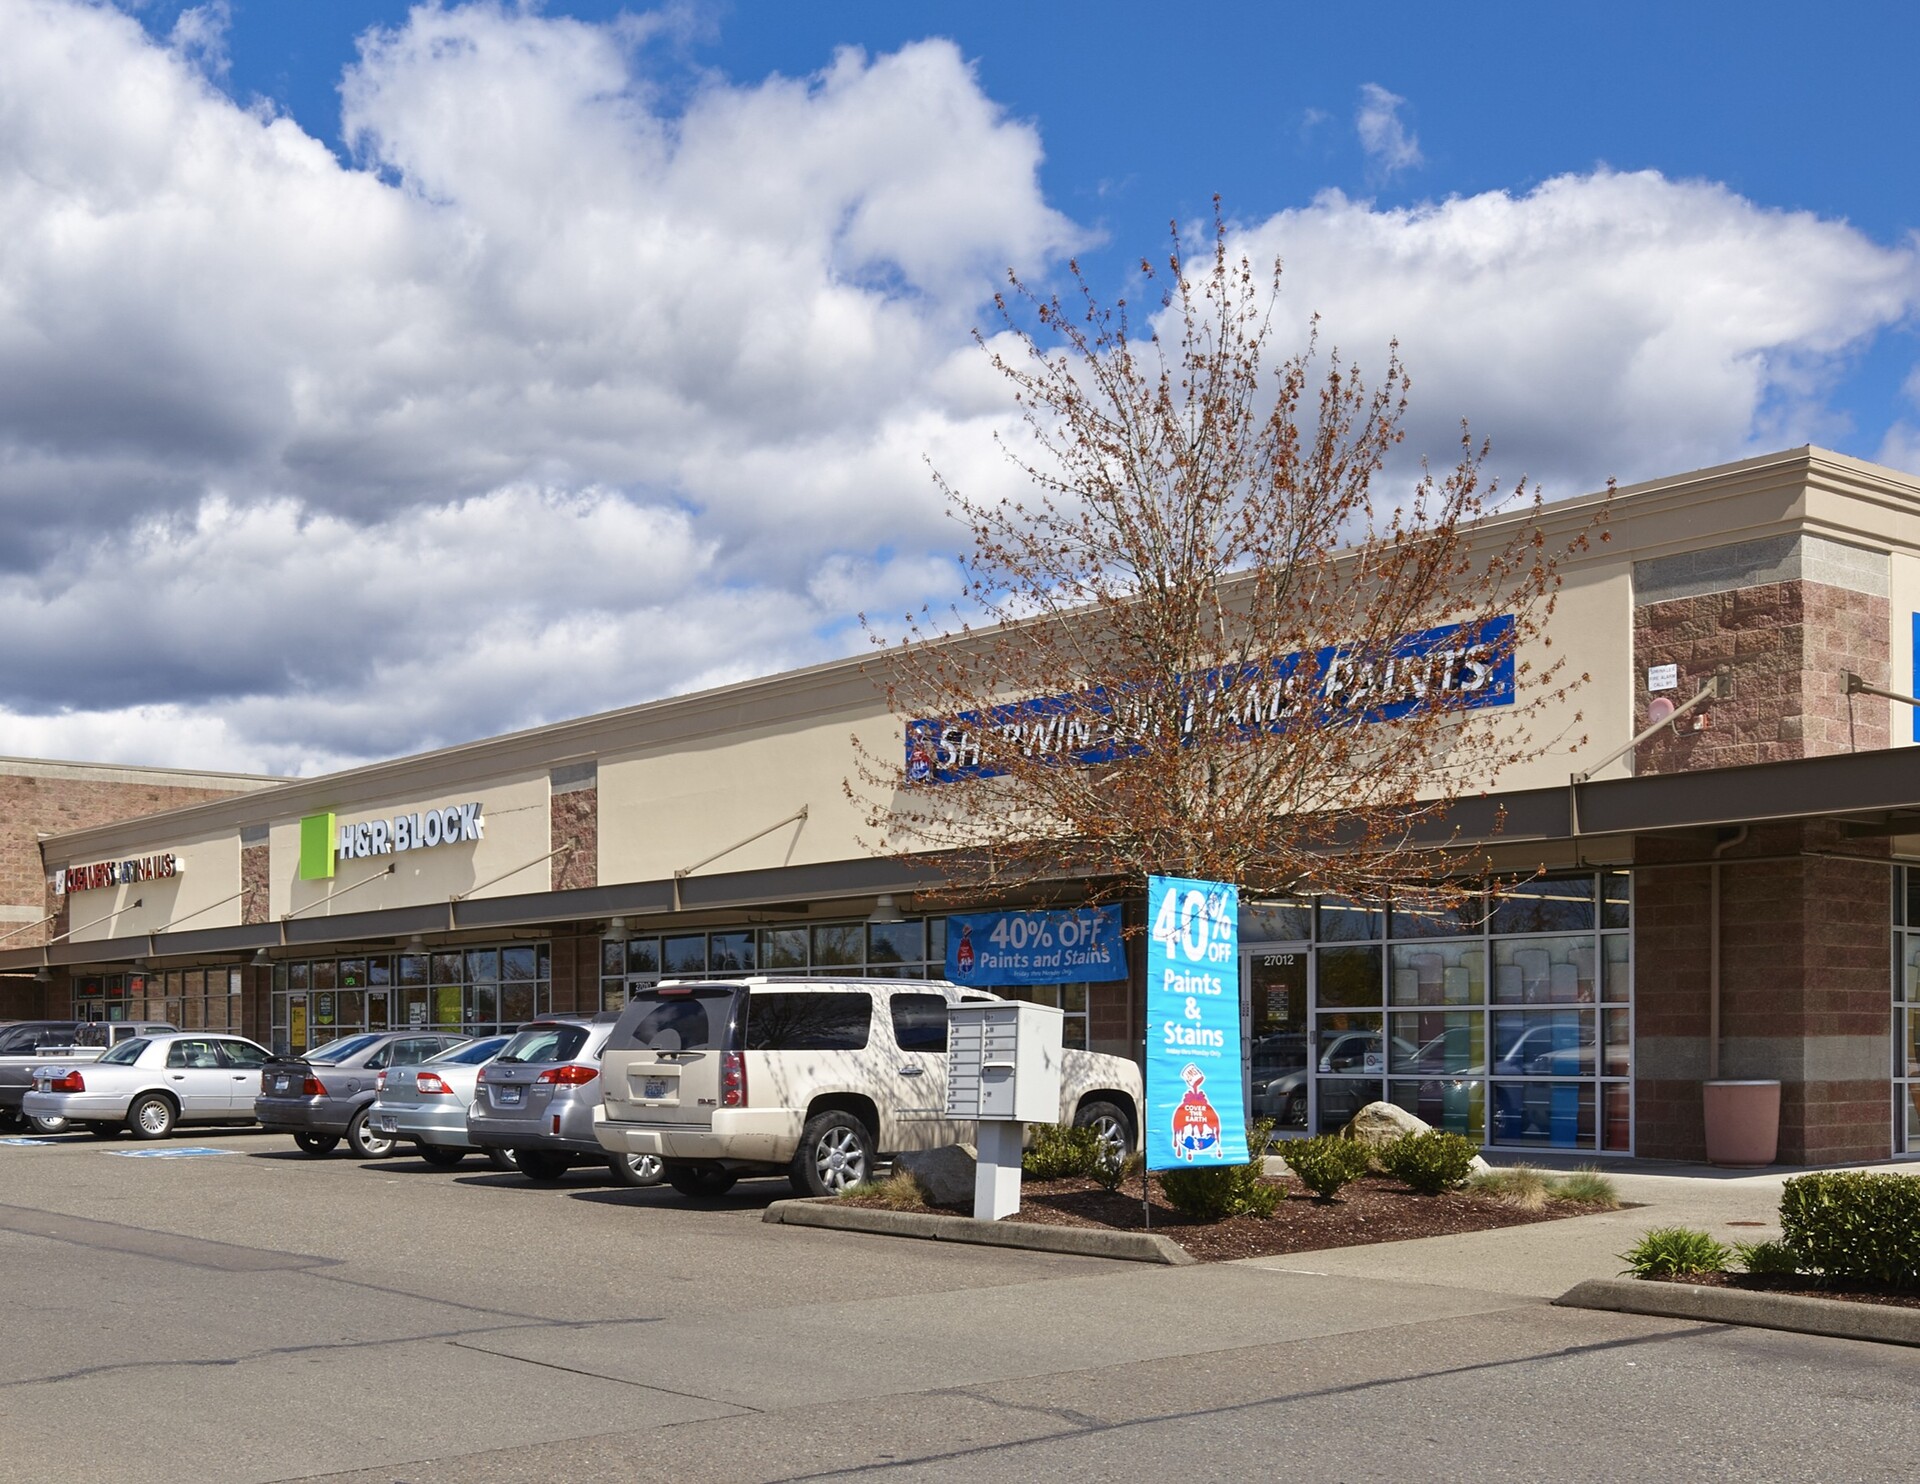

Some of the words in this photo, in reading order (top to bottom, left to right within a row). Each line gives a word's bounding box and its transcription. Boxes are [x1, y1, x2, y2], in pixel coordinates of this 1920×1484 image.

[340, 819, 391, 859] H&R
[394, 802, 482, 851] BLOCK
[137, 853, 176, 881] NAILS
[989, 917, 1053, 949] 40%
[1058, 918, 1104, 947] OFF
[1152, 886, 1232, 962] 40%
[1207, 942, 1232, 963] OFF
[980, 951, 1029, 968] Paints
[1033, 949, 1062, 967] and
[1064, 949, 1111, 966] Stains
[1264, 954, 1294, 966] 27012
[1163, 968, 1222, 995] Paints
[1184, 996, 1202, 1020] &
[1163, 1020, 1224, 1047] Stains
